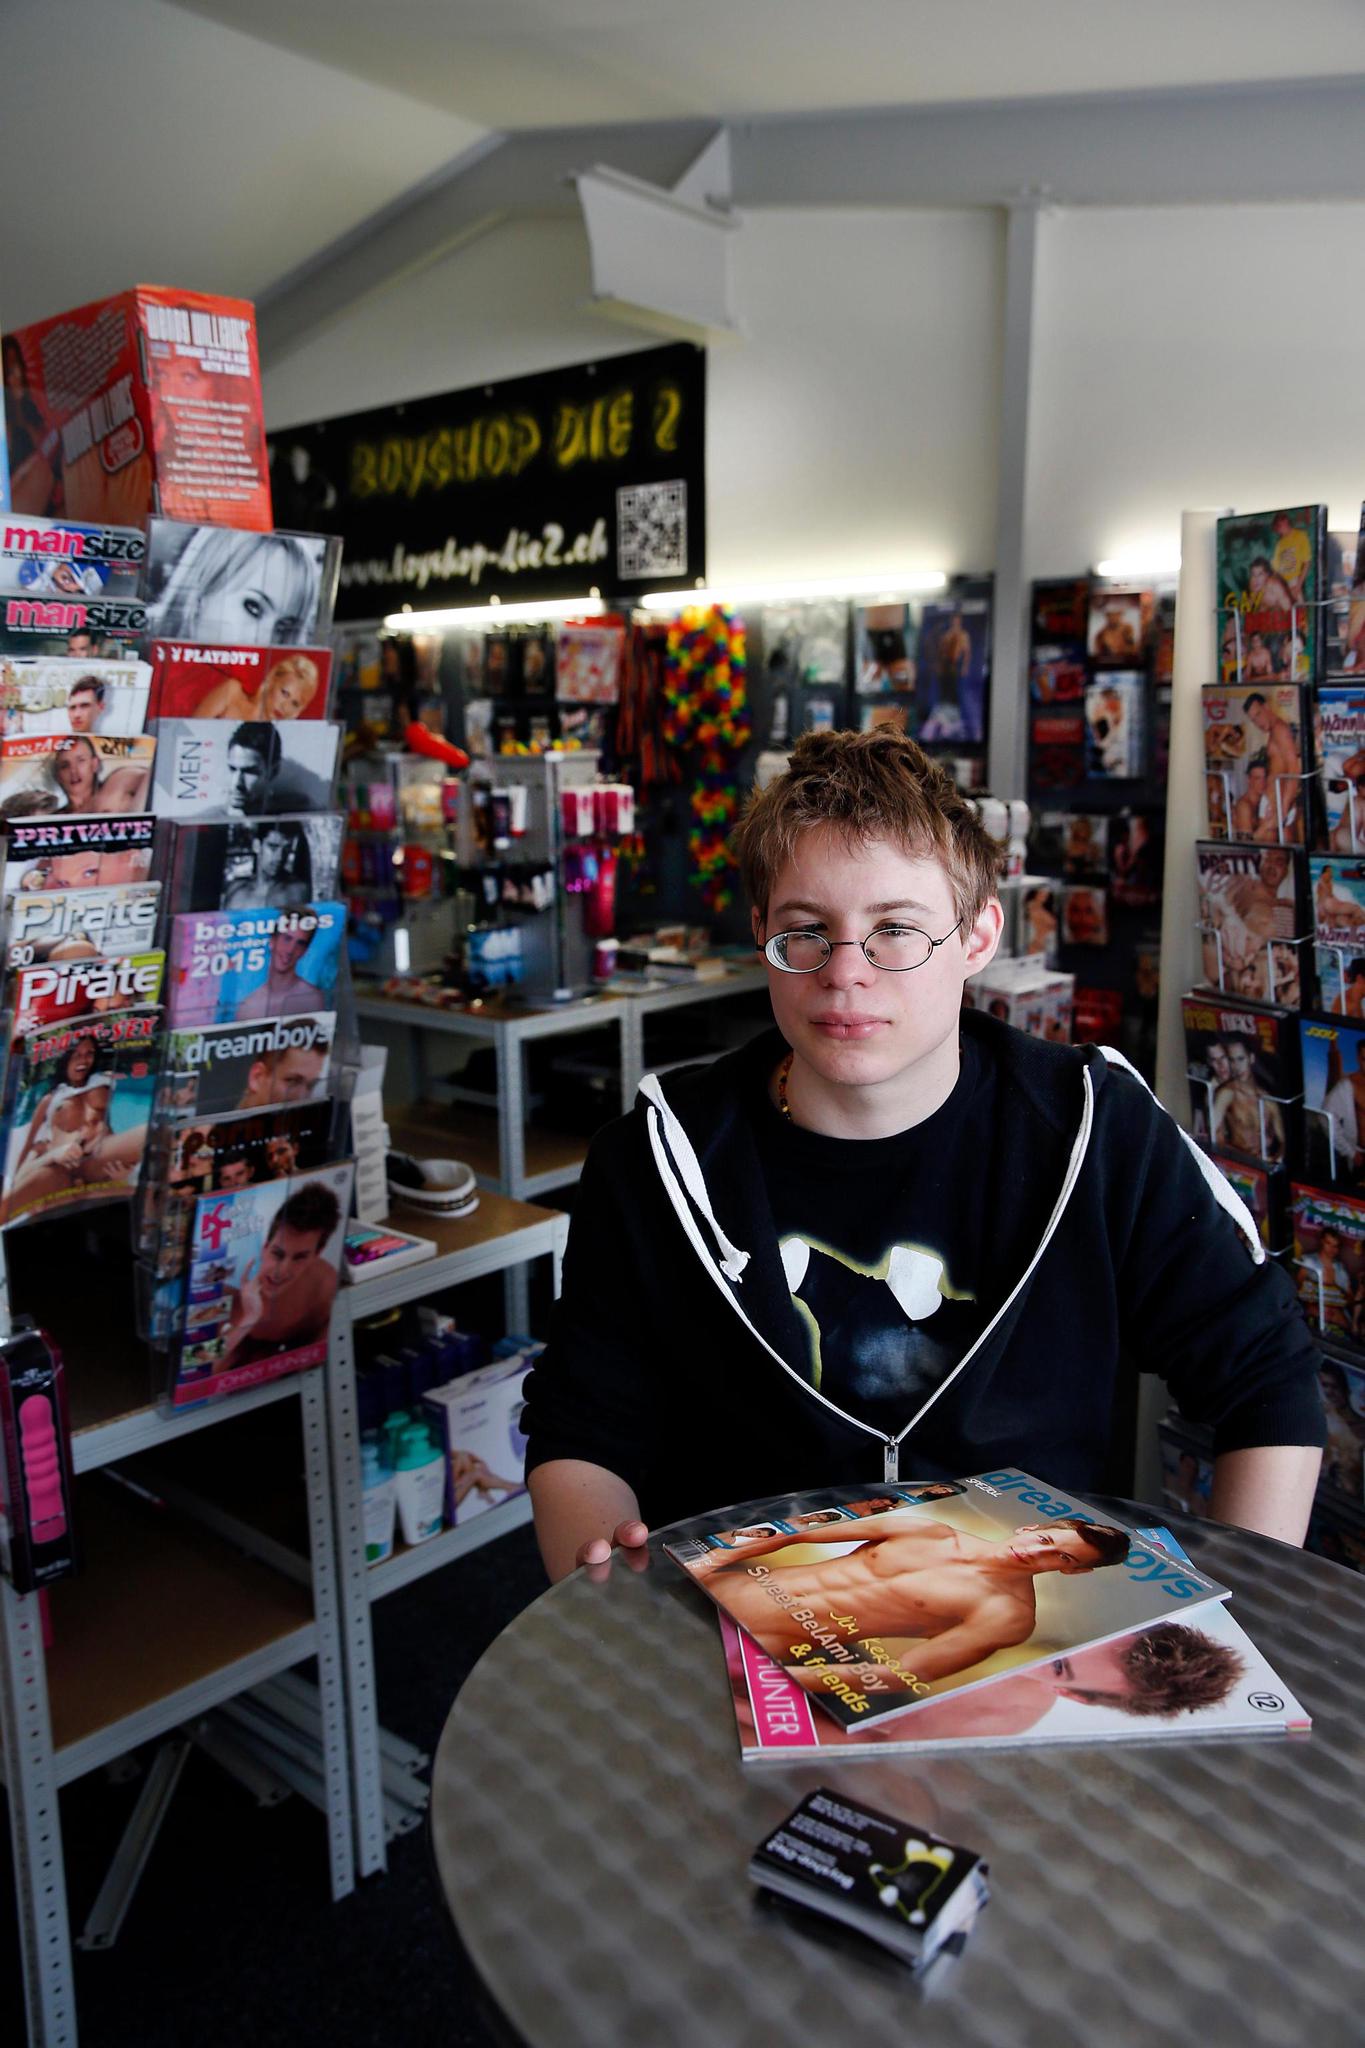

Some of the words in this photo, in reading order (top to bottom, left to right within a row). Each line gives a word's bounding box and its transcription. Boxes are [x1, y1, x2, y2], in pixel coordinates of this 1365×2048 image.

[352, 414, 540, 497] BOYSHOP
[554, 390, 634, 468] DIE
[653, 388, 682, 451] 2
[4, 527, 145, 560] mansize
[6, 600, 147, 629] mansize
[184, 649, 259, 666] PLAYBOY'S
[177, 741, 201, 800] MEN
[12, 820, 153, 848] PRIVATE
[15, 895, 157, 941] Pirate
[195, 912, 335, 941] beauties
[191, 948, 266, 979] 2015
[193, 937, 270, 954] Kalender
[20, 958, 160, 1011] Pirate
[185, 1021, 332, 1064] dreamboys
[981, 1472, 1206, 1599] dreaoys
[748, 1565, 800, 1610] Sweet
[791, 1608, 860, 1663] BelAmi
[850, 1661, 889, 1692] Boy
[755, 1655, 800, 1736] HUNTER
[790, 1643, 812, 1659] &
[804, 1656, 871, 1714] friends
